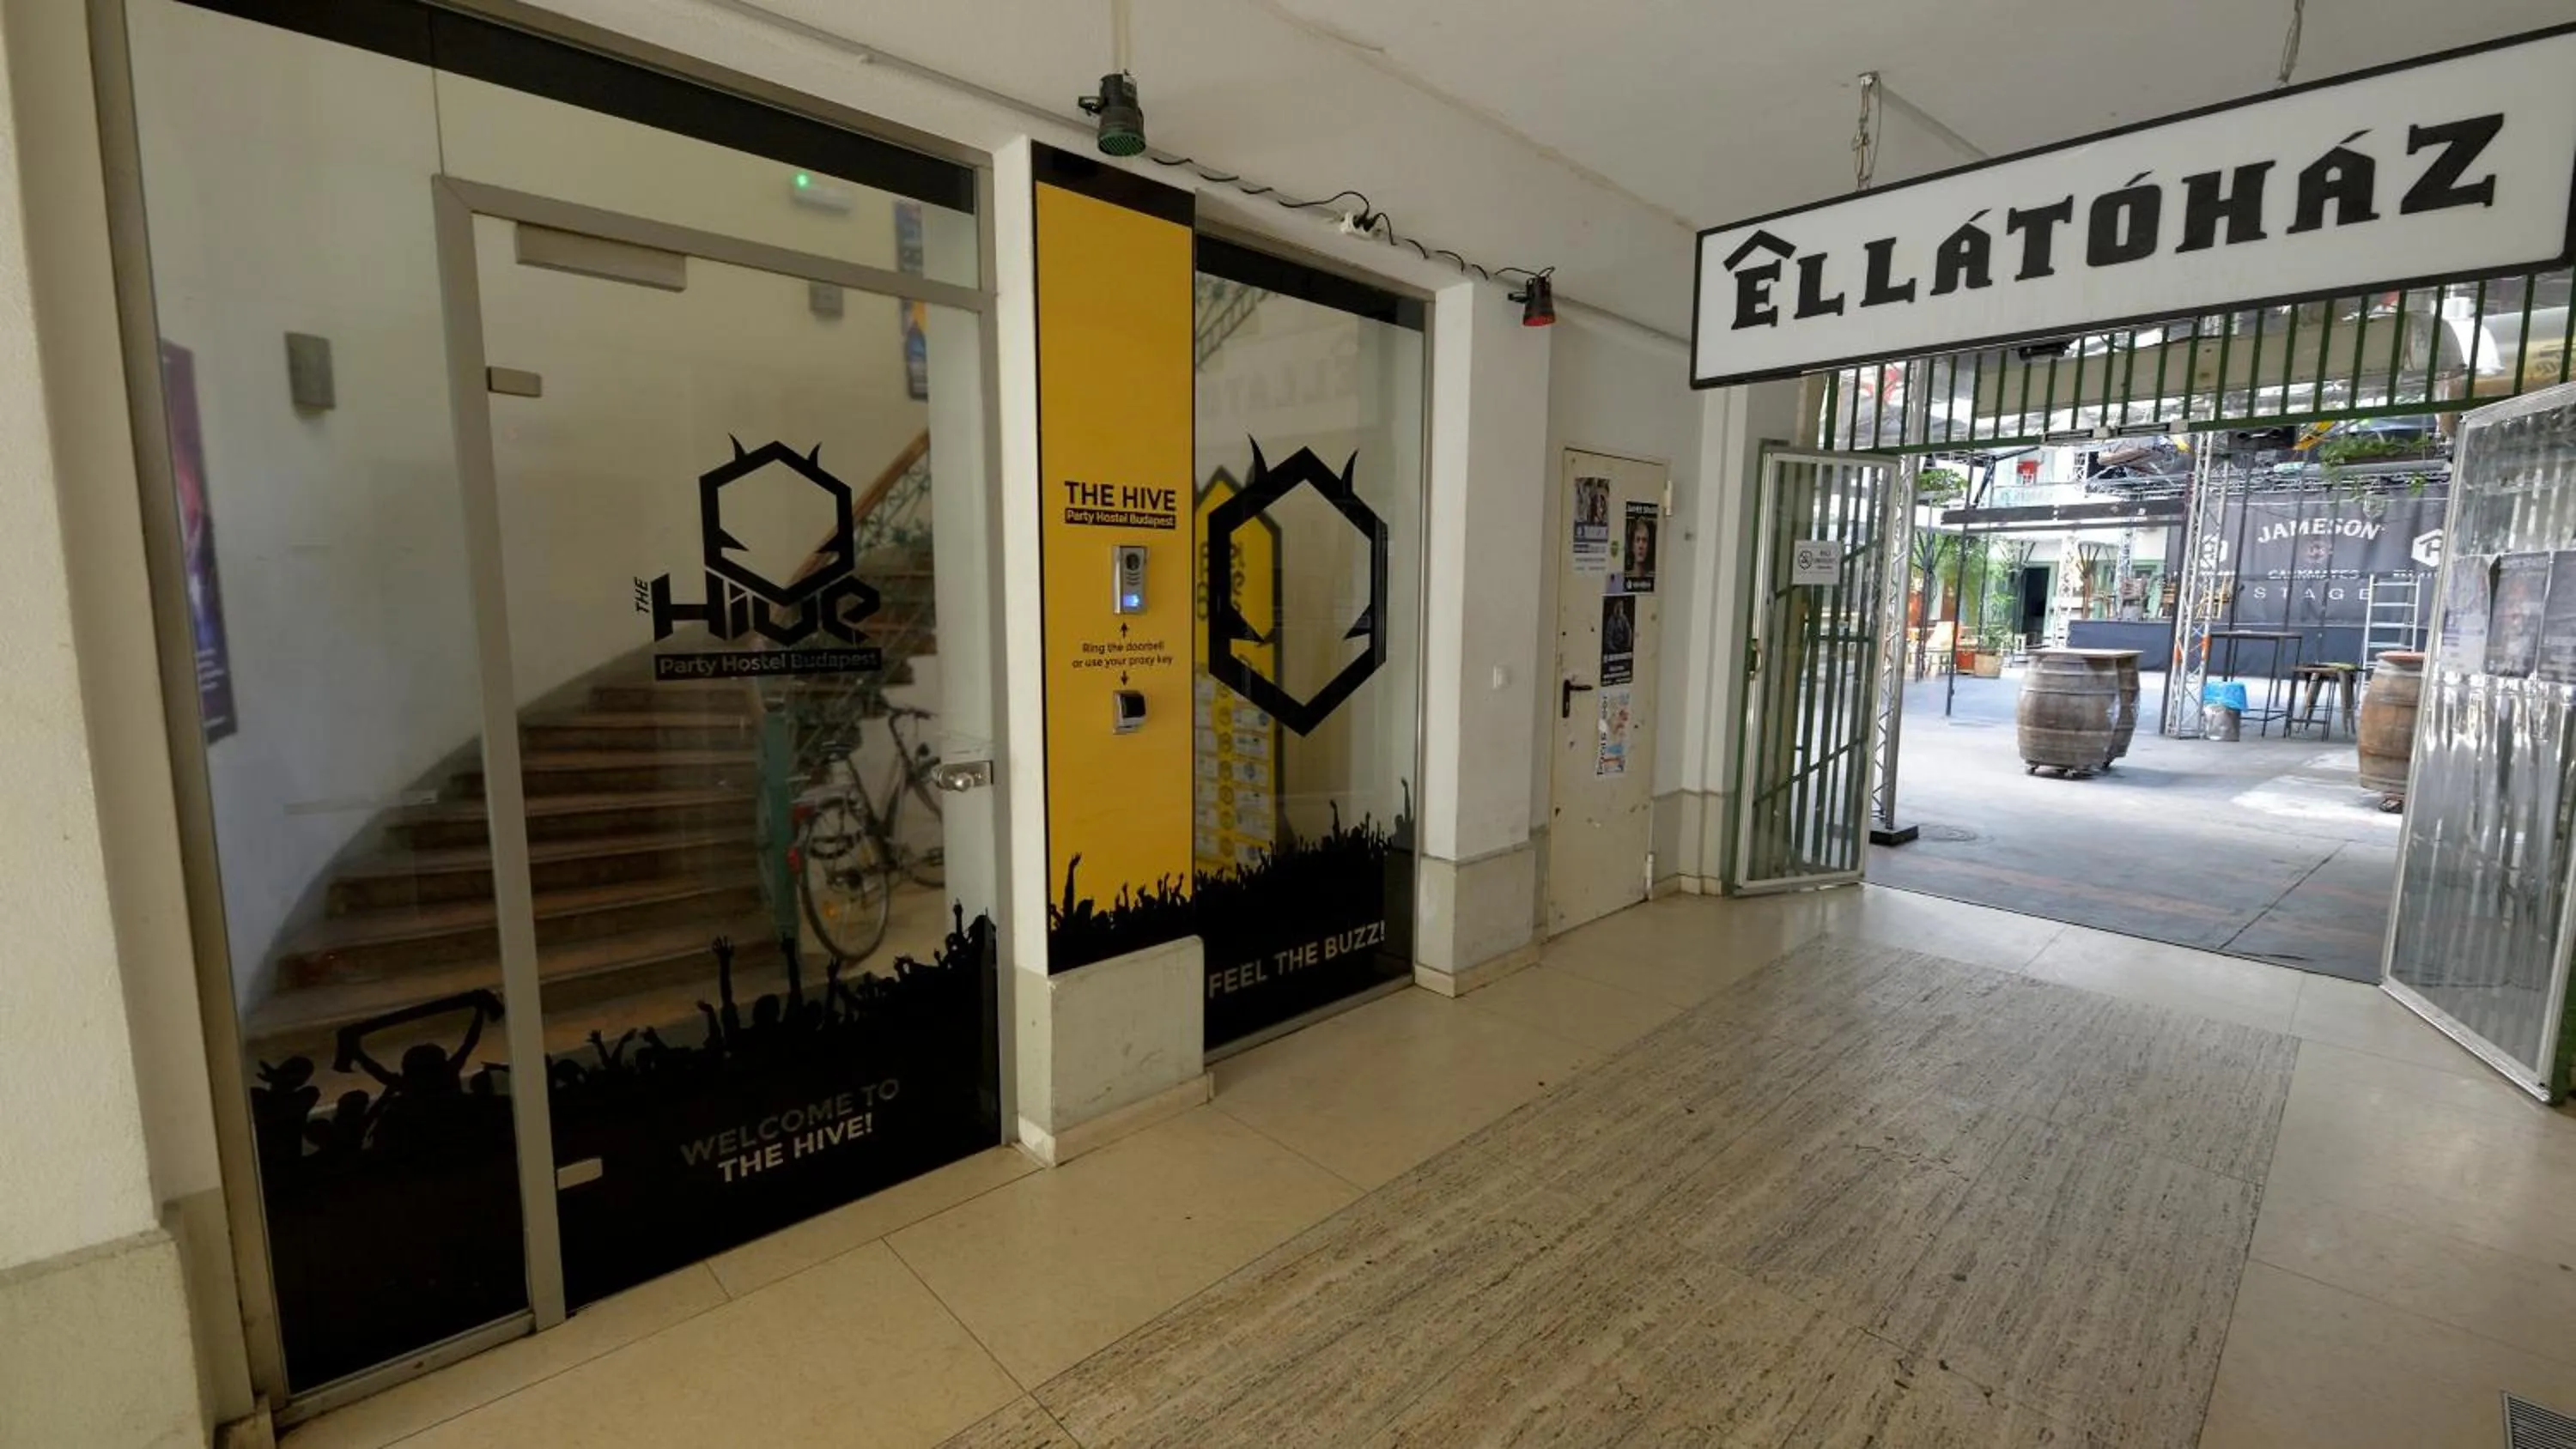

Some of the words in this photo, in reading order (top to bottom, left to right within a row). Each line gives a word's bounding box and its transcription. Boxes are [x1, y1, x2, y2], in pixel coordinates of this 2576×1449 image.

[1064, 480, 1115, 506] THE
[1122, 485, 1176, 511] HIVE
[1066, 510, 1095, 524] Party
[1096, 511, 1128, 524] Hostel
[1129, 514, 1175, 528] Budapest
[2258, 517, 2380, 543] JAMESON
[634, 577, 650, 614] THE
[1072, 659, 1084, 669] or
[1084, 658, 1103, 667] use
[1104, 658, 1127, 669] your
[1157, 653, 1174, 665] key
[1082, 643, 1105, 654] Ring
[1107, 642, 1124, 652] the
[659, 654, 714, 676] Party
[722, 652, 786, 672] Hostel
[791, 650, 878, 670] Budapest
[1208, 960, 1268, 999] FEEL
[1273, 942, 1319, 976] THE
[1324, 919, 1386, 961] BUZZ!
[680, 1092, 854, 1167] WELCOME
[860, 1078, 900, 1107] TO
[718, 1143, 784, 1183] THE
[793, 1112, 873, 1159] HIVE!
